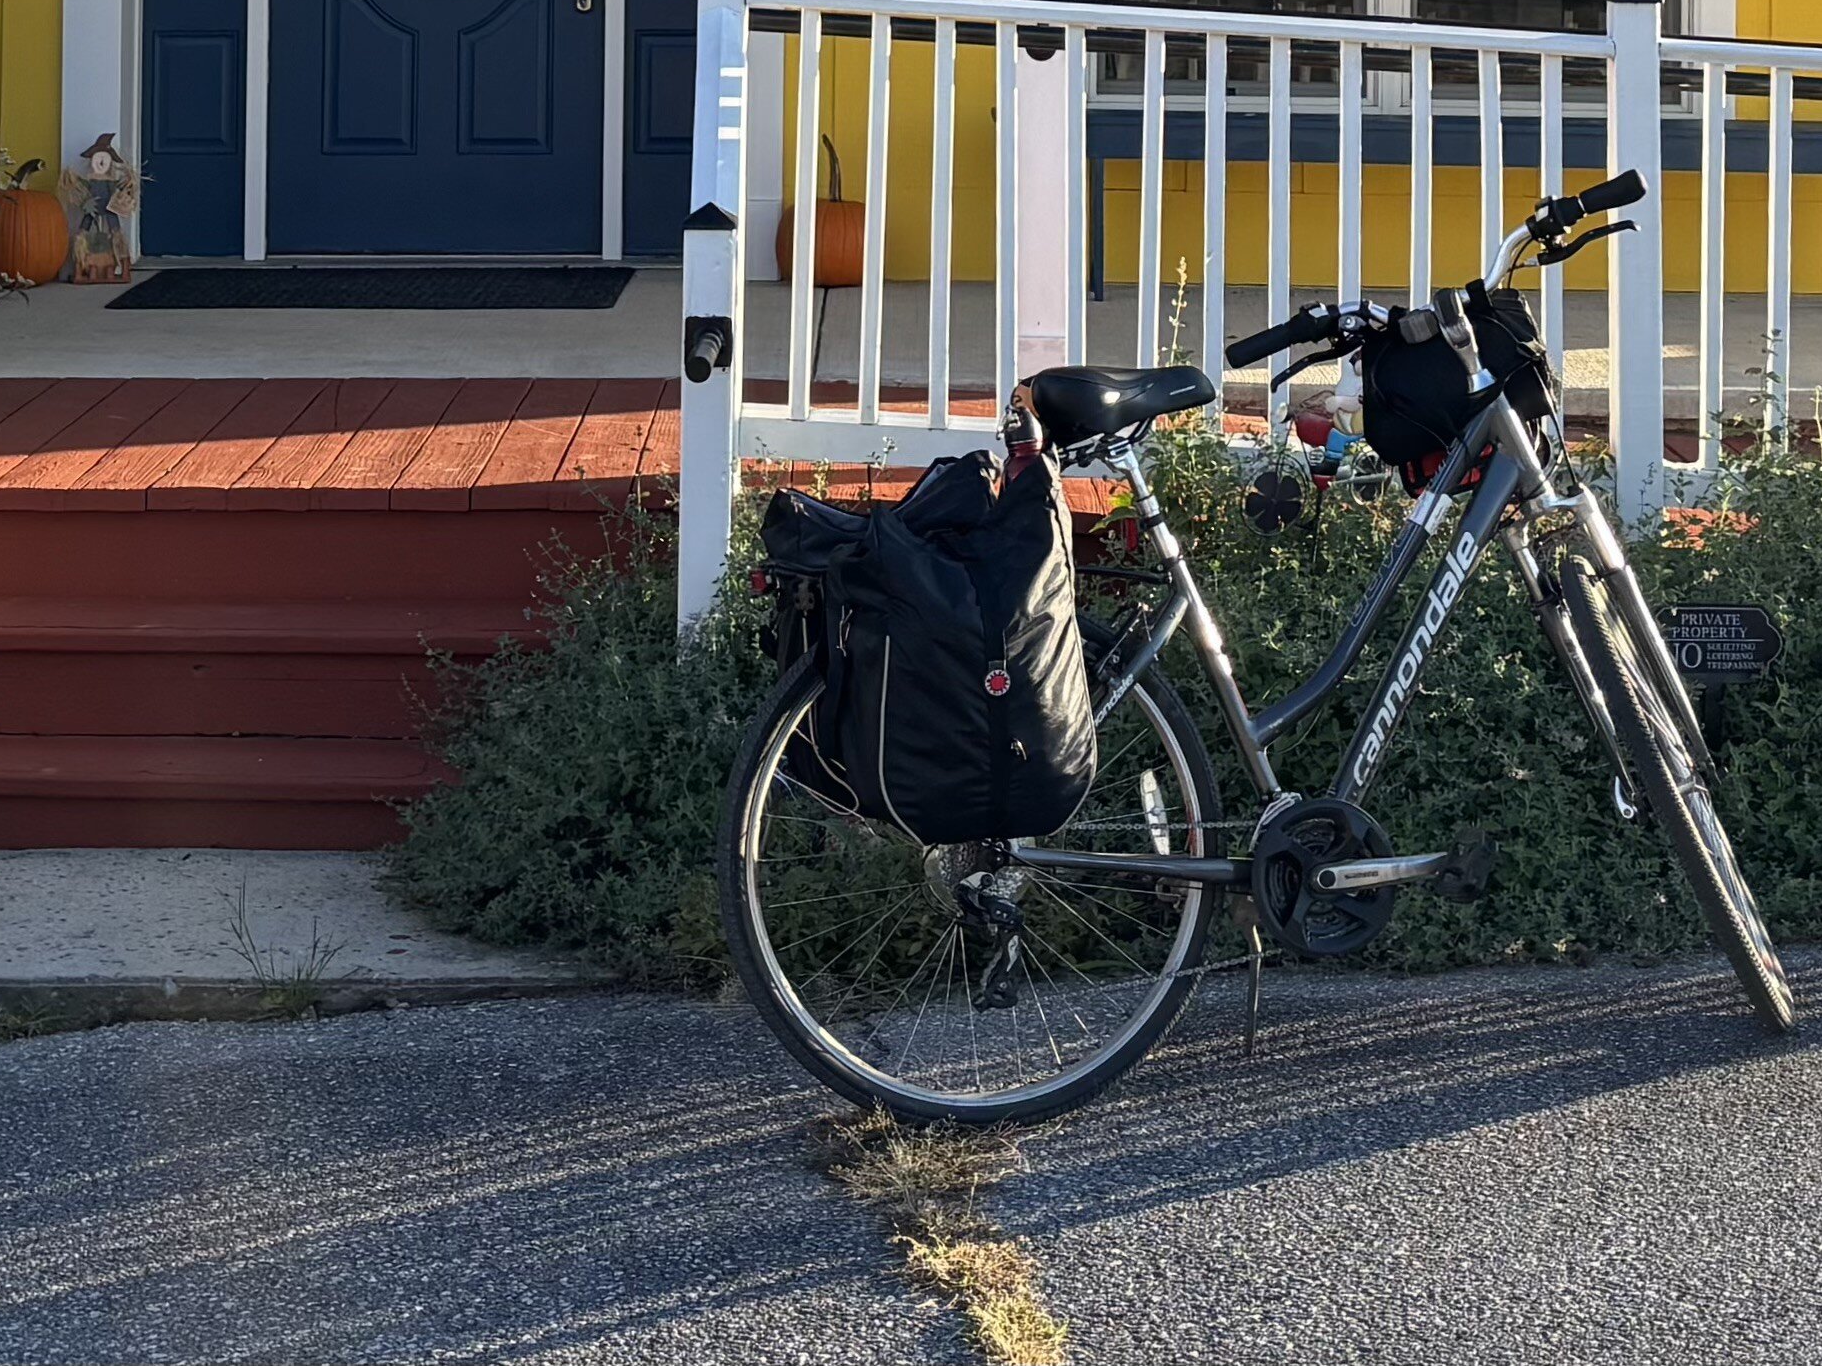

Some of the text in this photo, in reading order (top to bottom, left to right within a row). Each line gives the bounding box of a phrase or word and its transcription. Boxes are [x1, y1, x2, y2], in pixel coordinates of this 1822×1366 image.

[1681, 613, 1741, 626] PRIVATE
[1672, 626, 1748, 639] PROPERTY
[1353, 530, 1479, 788] cannondale
